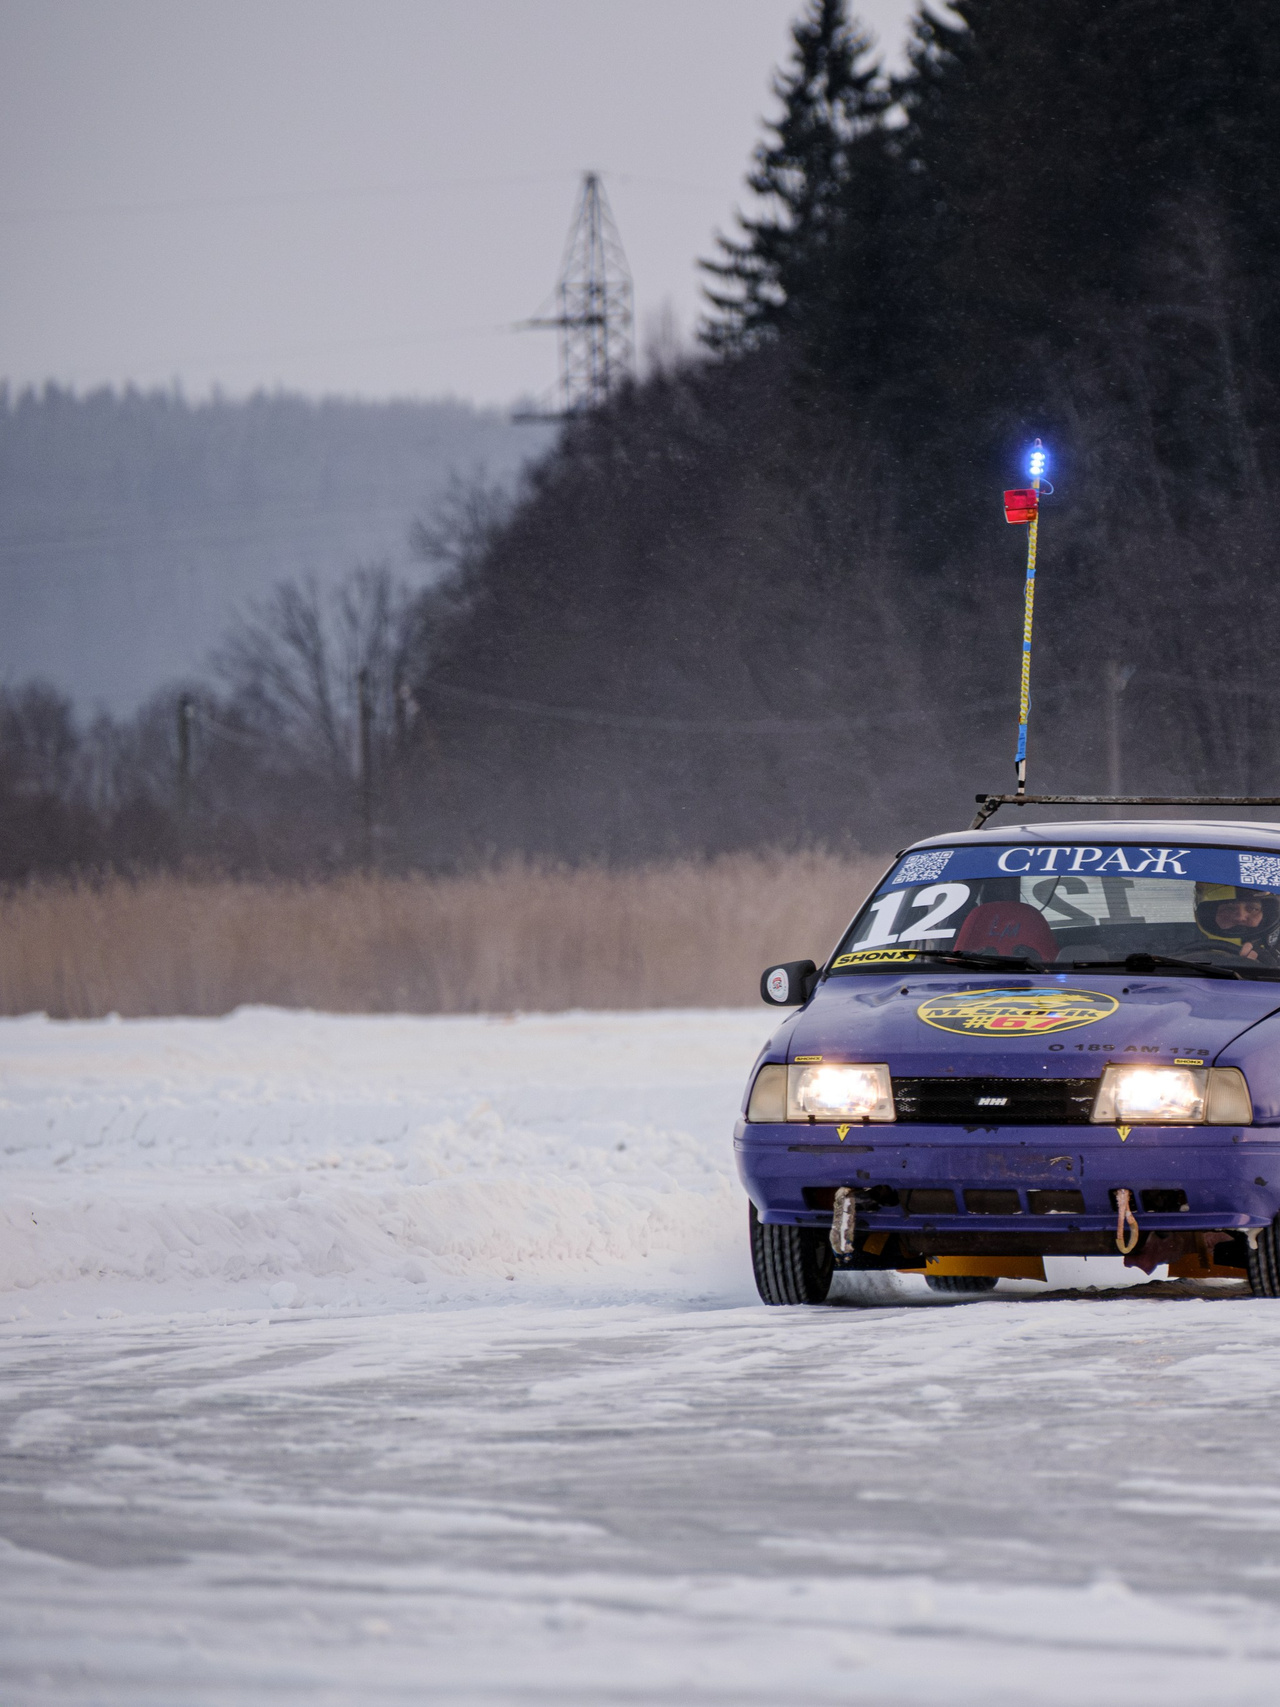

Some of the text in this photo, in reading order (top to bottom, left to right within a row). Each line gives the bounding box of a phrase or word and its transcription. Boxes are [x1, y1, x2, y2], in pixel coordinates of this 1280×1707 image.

[997, 847, 1191, 875] СТРАЖ
[851, 882, 970, 952] 12
[837, 950, 913, 966] SHONX
